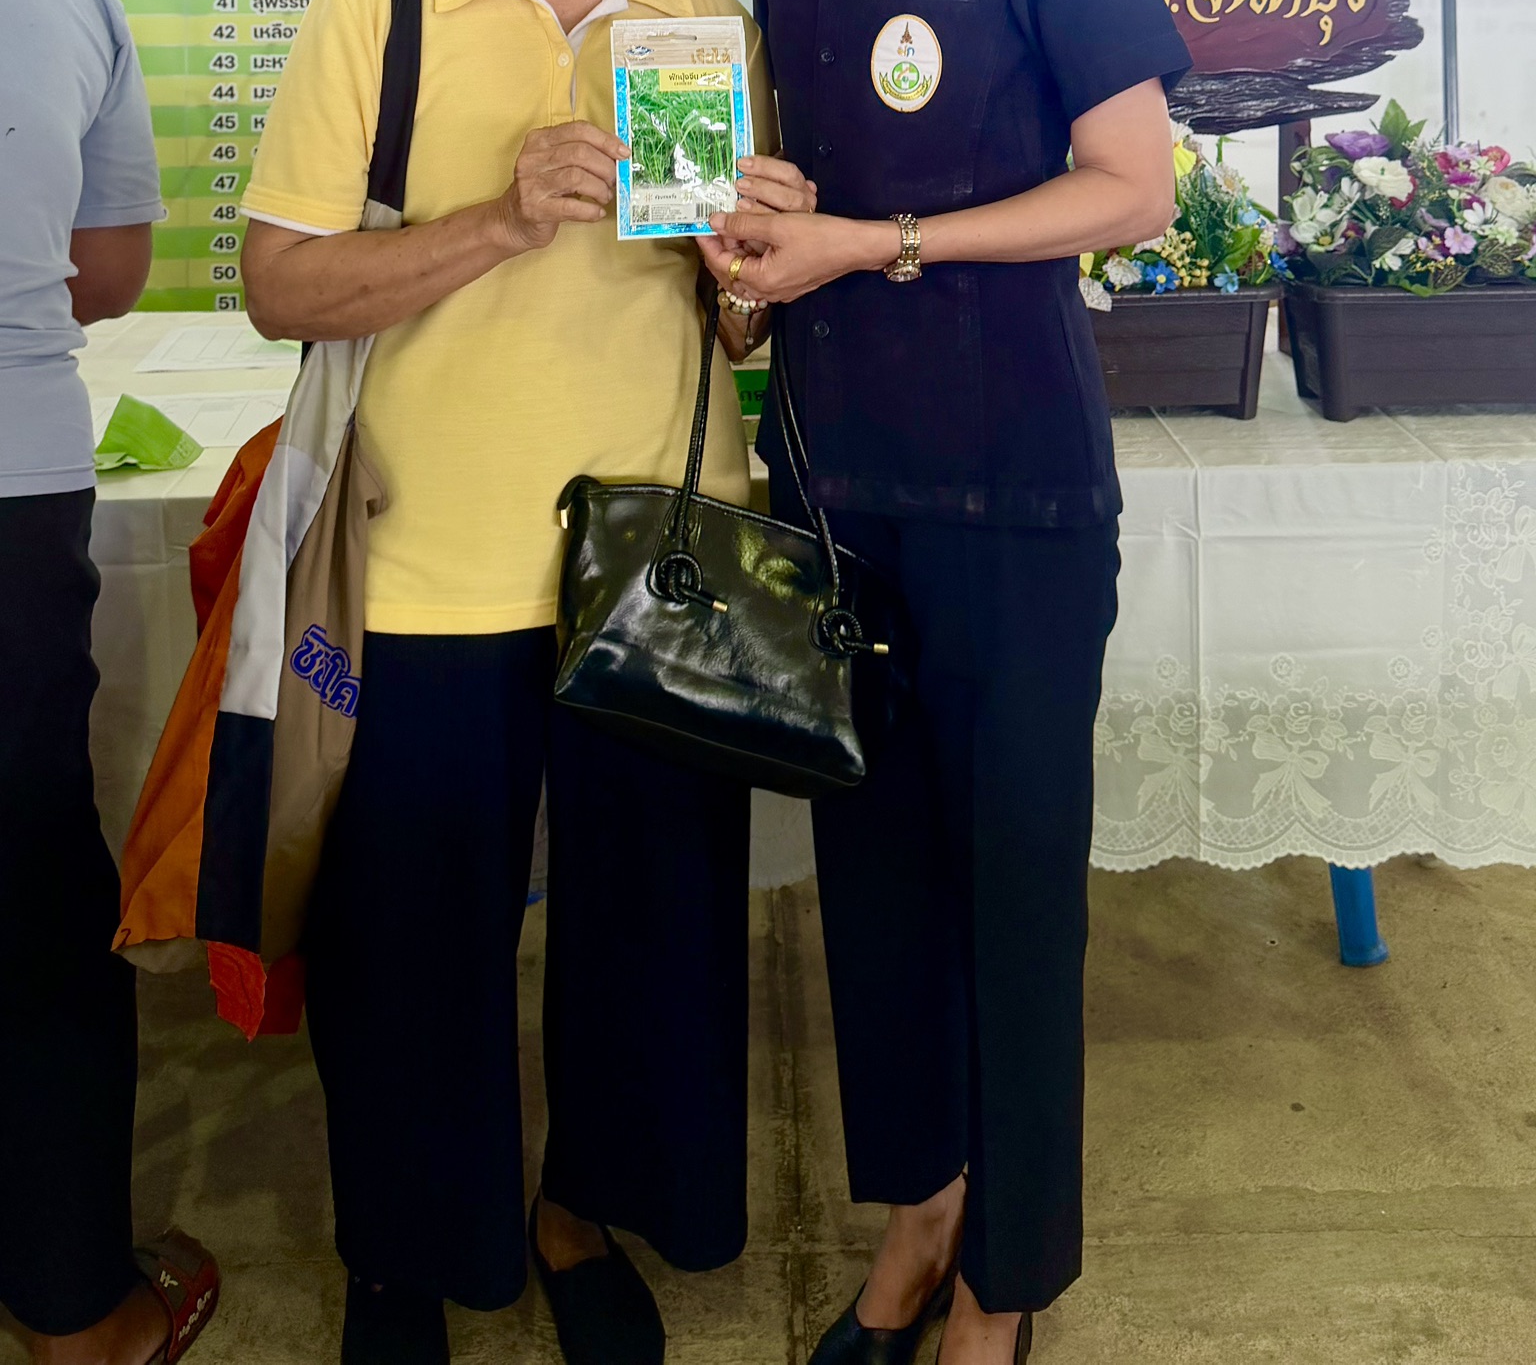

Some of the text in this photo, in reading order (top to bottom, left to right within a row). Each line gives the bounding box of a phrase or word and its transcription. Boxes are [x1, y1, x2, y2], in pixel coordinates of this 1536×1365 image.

[213, 25, 235, 40] 42
[213, 56, 236, 70] 43
[213, 86, 235, 100] 44
[213, 116, 236, 130] 45
[213, 146, 236, 161] 46
[214, 176, 237, 191] 47
[213, 206, 236, 221] 48
[213, 237, 236, 251] 49
[213, 267, 236, 281] 50
[218, 297, 237, 311] 51
